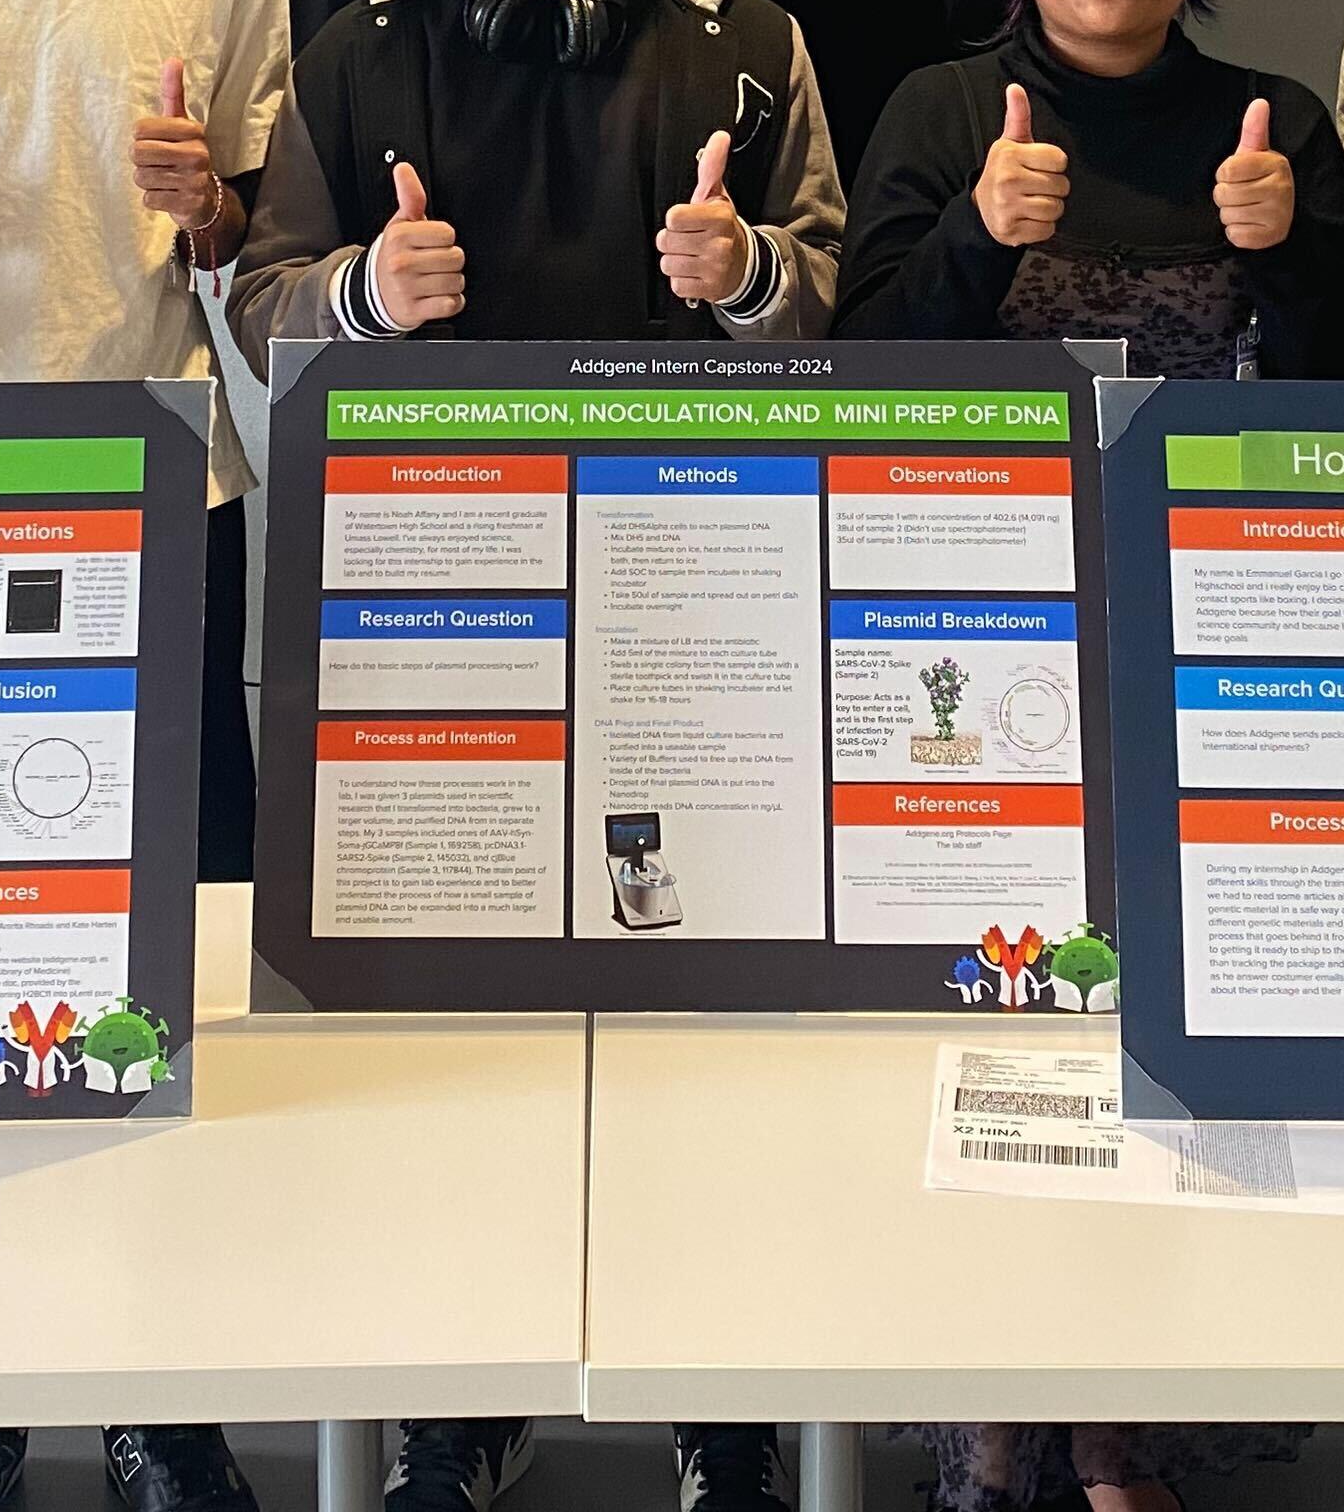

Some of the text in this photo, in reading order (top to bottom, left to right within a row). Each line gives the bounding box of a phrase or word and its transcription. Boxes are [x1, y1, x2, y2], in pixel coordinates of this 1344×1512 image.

[570, 359, 832, 376] Addgene Intern Capstone 2024
[337, 403, 1059, 424] TRANSFORMATION, INOCULATION, AND MINI PREP OF DNA
[392, 466, 501, 481] Introduction
[659, 467, 737, 482] Methods
[889, 467, 1009, 482] Observations
[360, 610, 532, 626] Research Question
[865, 611, 1046, 628] Plasmid Breakdown
[835, 648, 865, 656] Sample
[835, 659, 911, 668] SARS-CoV-2 Spike
[835, 671, 878, 680] (Sample 2)
[1218, 679, 1312, 697] Research
[835, 693, 871, 701] Purpose:
[836, 704, 850, 713] key
[894, 704, 910, 712] cell,
[878, 715, 893, 723] first
[895, 716, 913, 724] step
[355, 731, 515, 744] Process and Intention
[836, 726, 844, 734] of
[884, 727, 894, 736] by
[836, 748, 876, 758] (Covid 19)
[895, 796, 1000, 812] References
[953, 1125, 1021, 1136] X2 HINA
